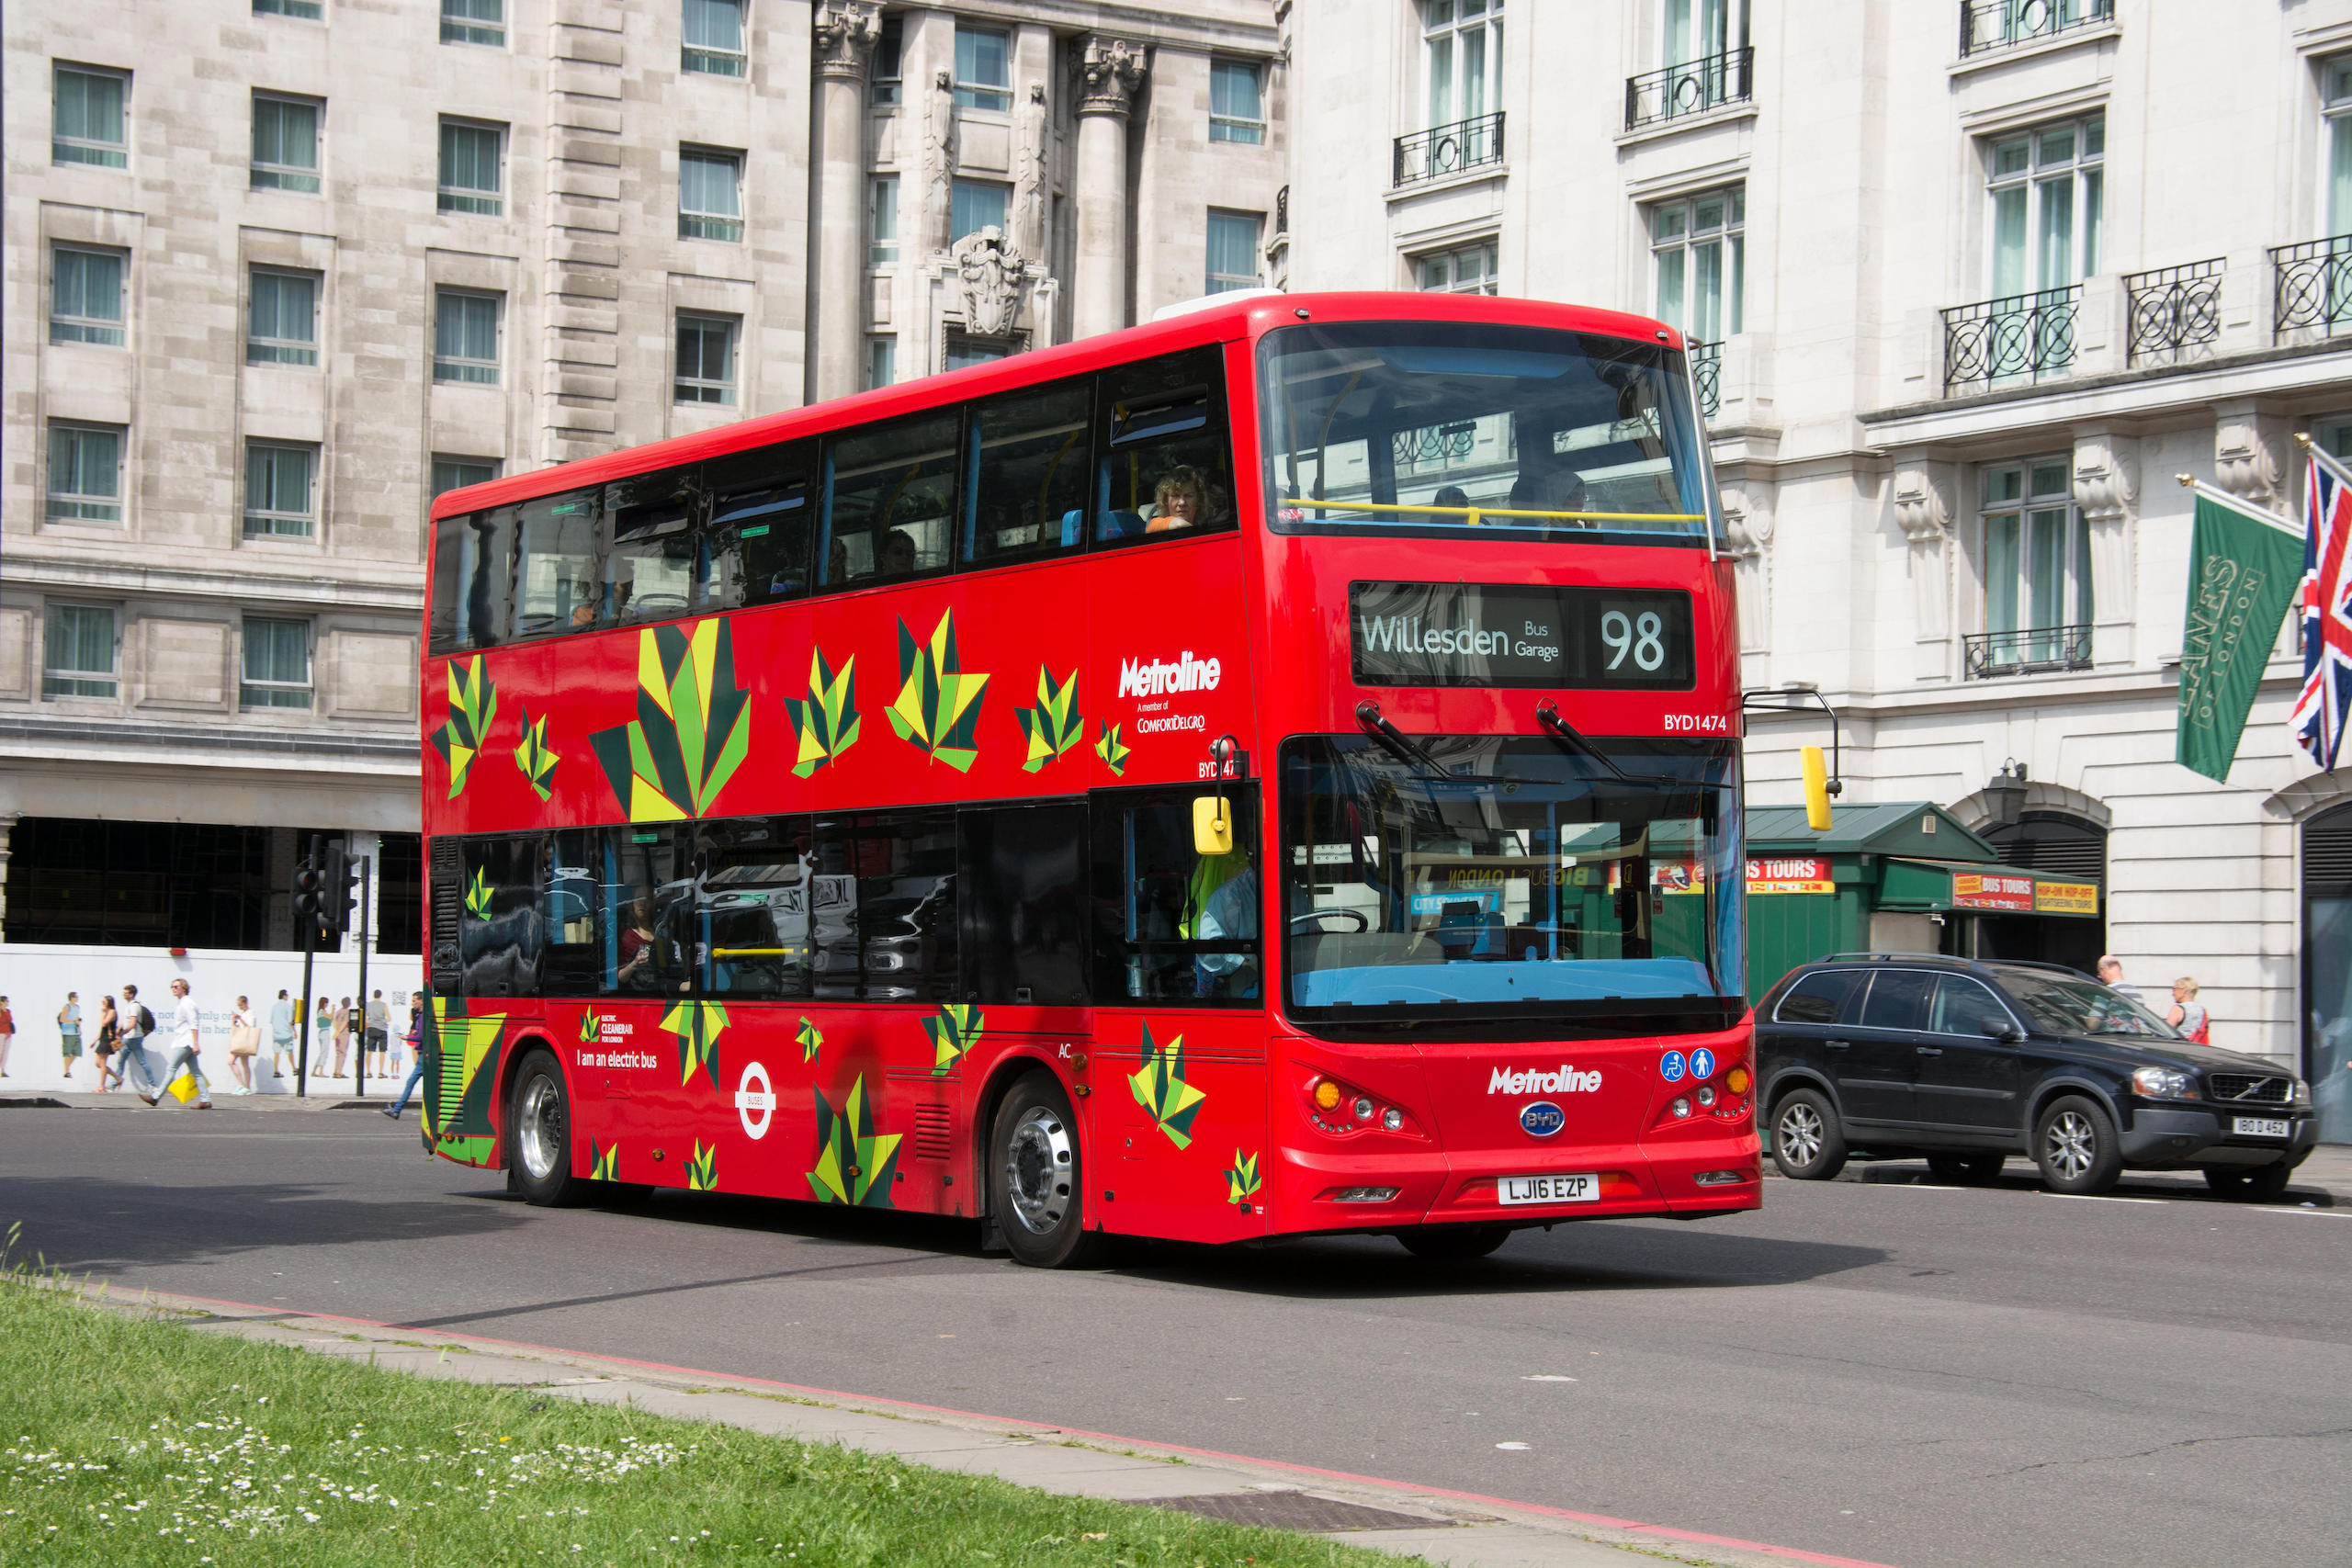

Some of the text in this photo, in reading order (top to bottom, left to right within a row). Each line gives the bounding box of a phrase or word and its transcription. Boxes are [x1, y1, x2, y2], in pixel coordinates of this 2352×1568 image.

[1360, 615, 1510, 656] Willesden
[1525, 620, 1548, 637] Bus
[1601, 610, 1665, 671] 98
[2199, 577, 2257, 718] OF LONDON
[1515, 640, 1559, 662] Garage
[1118, 650, 1221, 698] Metroline
[1137, 700, 1169, 713] A member of
[1664, 714, 1727, 732] BYD1474
[1764, 859, 1816, 878] TOURS
[1983, 877, 2001, 893] BUS
[2002, 878, 2030, 895] TOURS
[577, 1049, 657, 1068] I am an electric bus
[1058, 1043, 1071, 1058] AC
[1487, 1065, 1602, 1096] Metroline
[1526, 1112, 1560, 1127] BYD
[1509, 1178, 1588, 1200] LJ16 EZP
